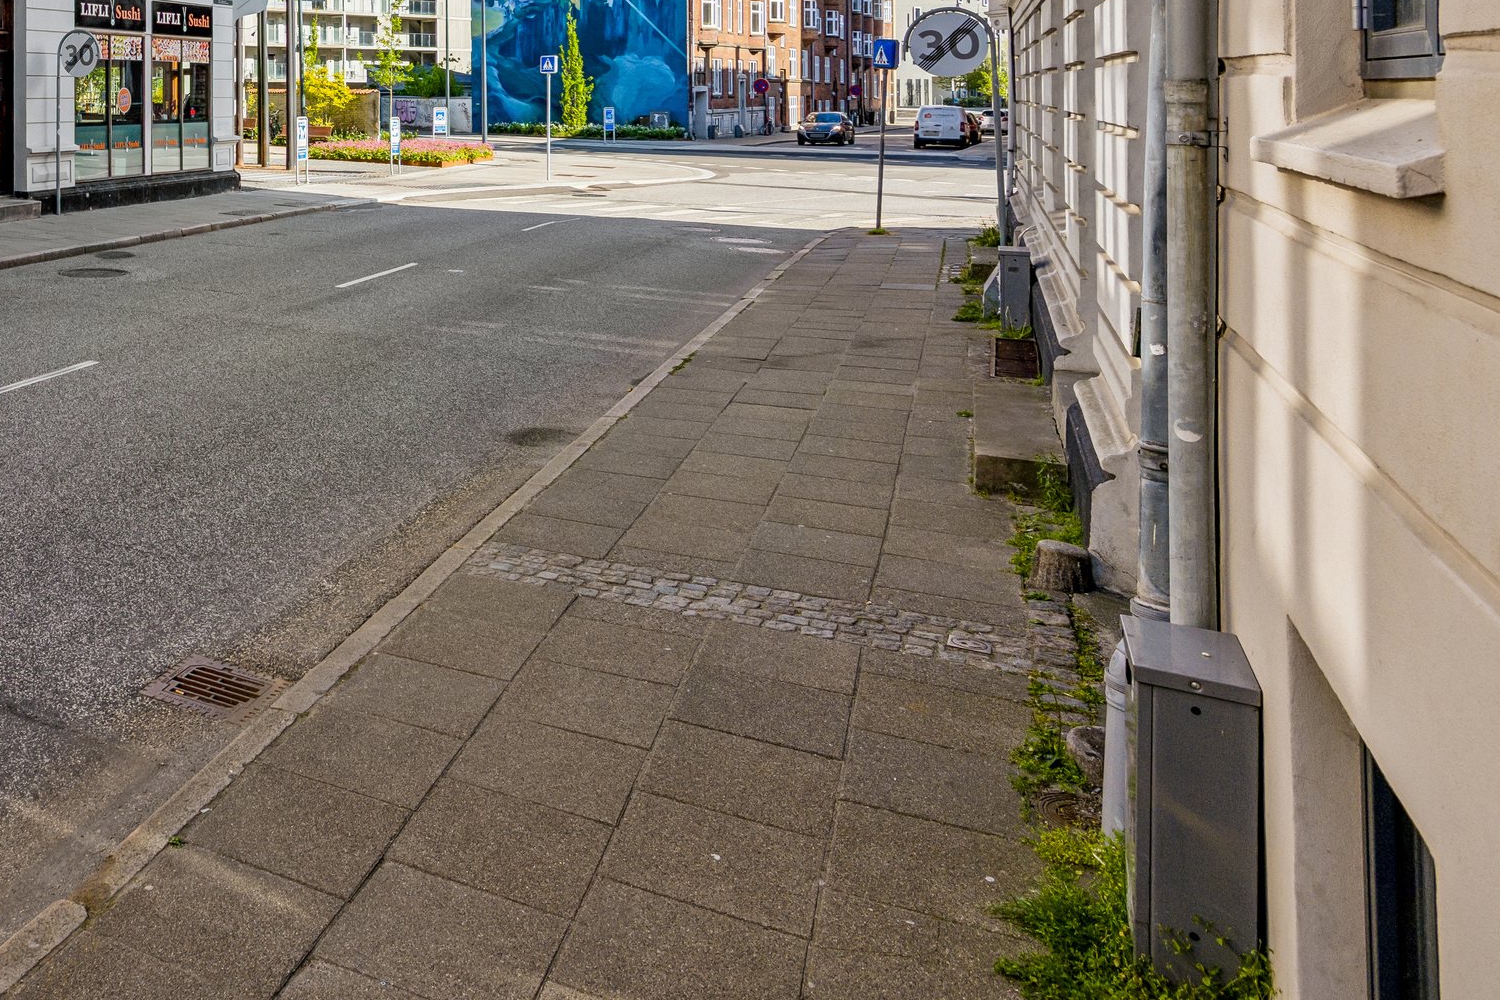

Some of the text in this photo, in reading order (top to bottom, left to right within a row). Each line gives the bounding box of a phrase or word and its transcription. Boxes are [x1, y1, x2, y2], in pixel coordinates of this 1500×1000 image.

[80, 2, 141, 21] LIFLI Sushi
[156, 11, 210, 28] LIFLI Sushi
[65, 44, 94, 66] 30
[917, 29, 980, 61] 30
